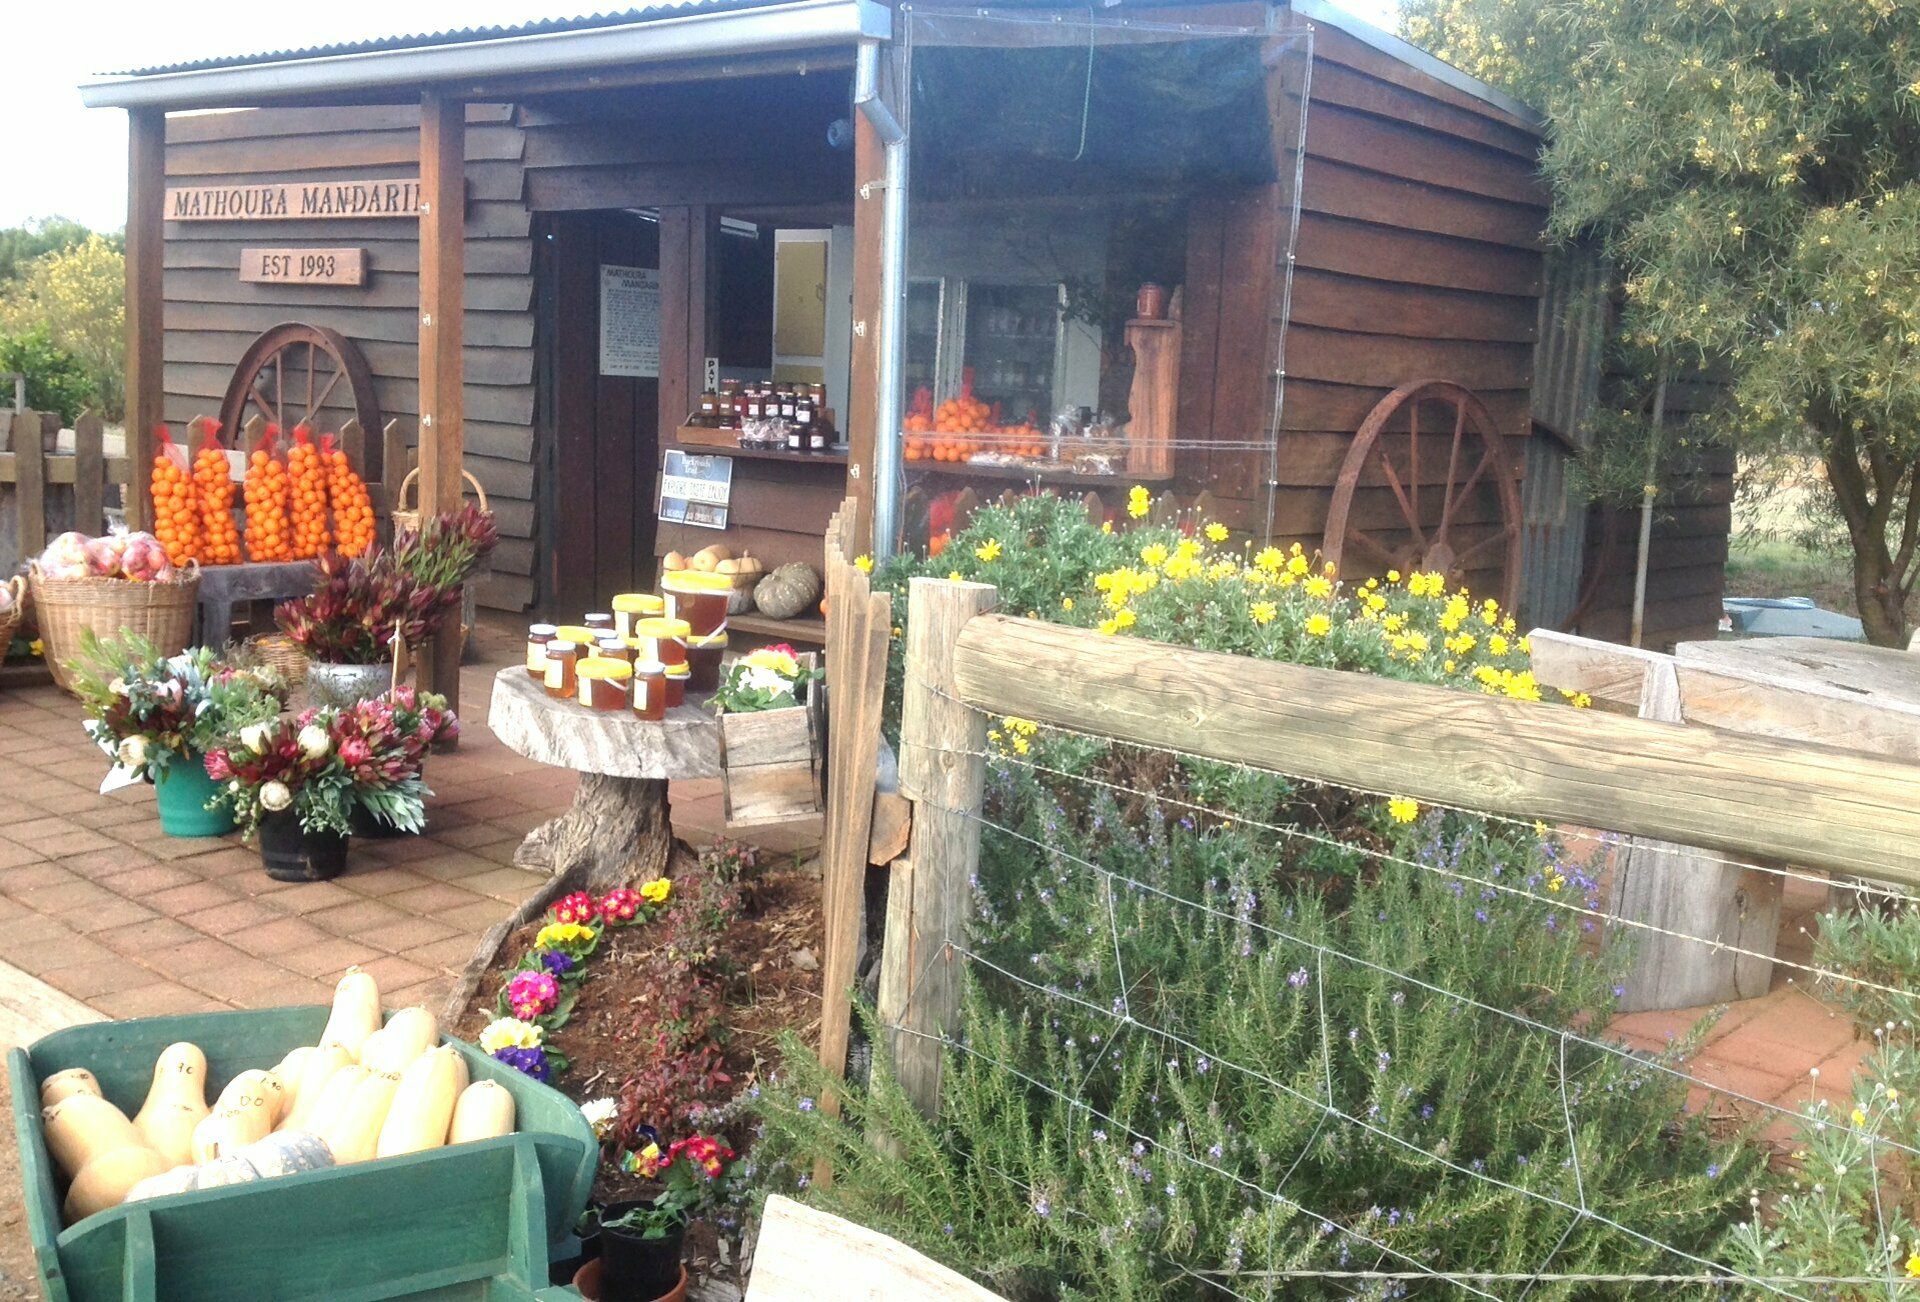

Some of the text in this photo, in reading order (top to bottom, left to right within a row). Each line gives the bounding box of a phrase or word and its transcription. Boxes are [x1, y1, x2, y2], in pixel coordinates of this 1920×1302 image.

[173, 188, 288, 217] MATHOURA
[261, 255, 336, 278] EST 1993
